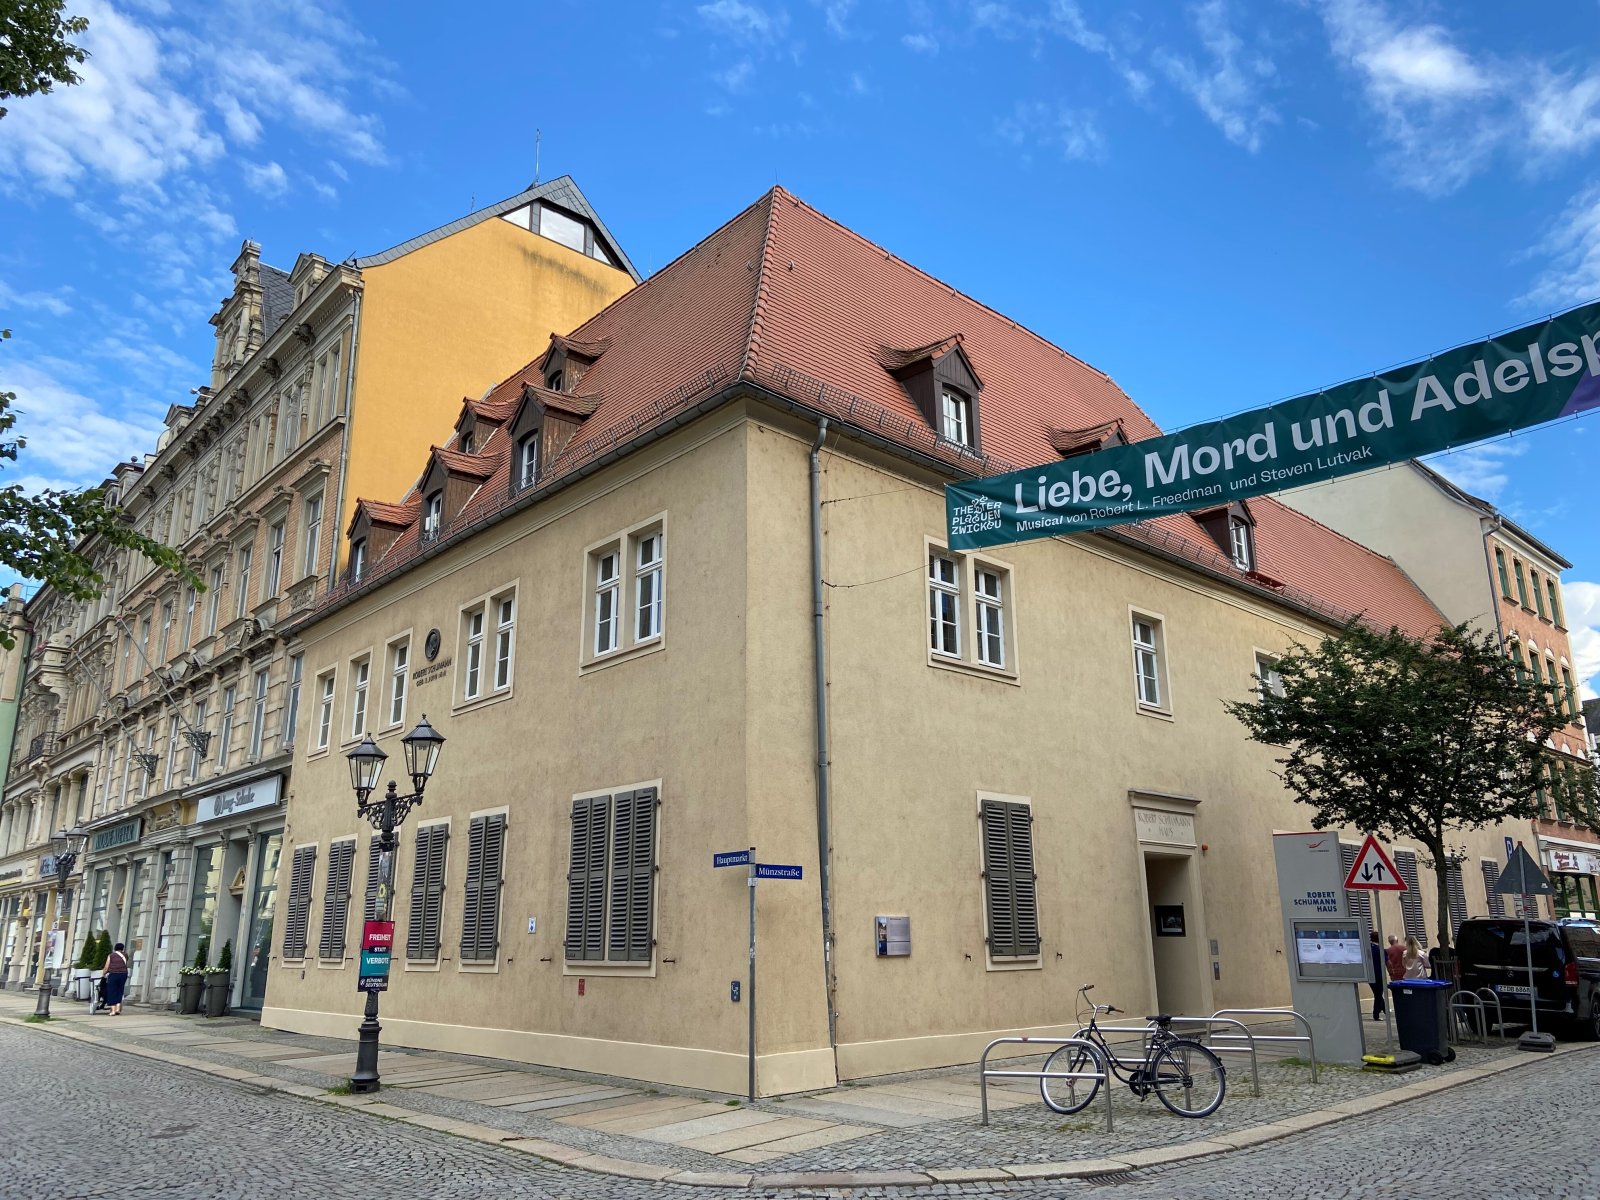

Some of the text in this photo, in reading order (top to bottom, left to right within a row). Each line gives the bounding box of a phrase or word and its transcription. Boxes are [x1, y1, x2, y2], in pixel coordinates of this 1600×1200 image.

[1015, 469, 1132, 514] Liebe,
[1144, 421, 1277, 488] Mord
[1291, 389, 1394, 451] und
[1016, 445, 1373, 532] Musical von Robert L. Freedman und Steven Lutvak
[758, 867, 800, 877] Münzstraße
[1307, 891, 1335, 899] ROBERT
[1294, 898, 1336, 906] SCHUMANN
